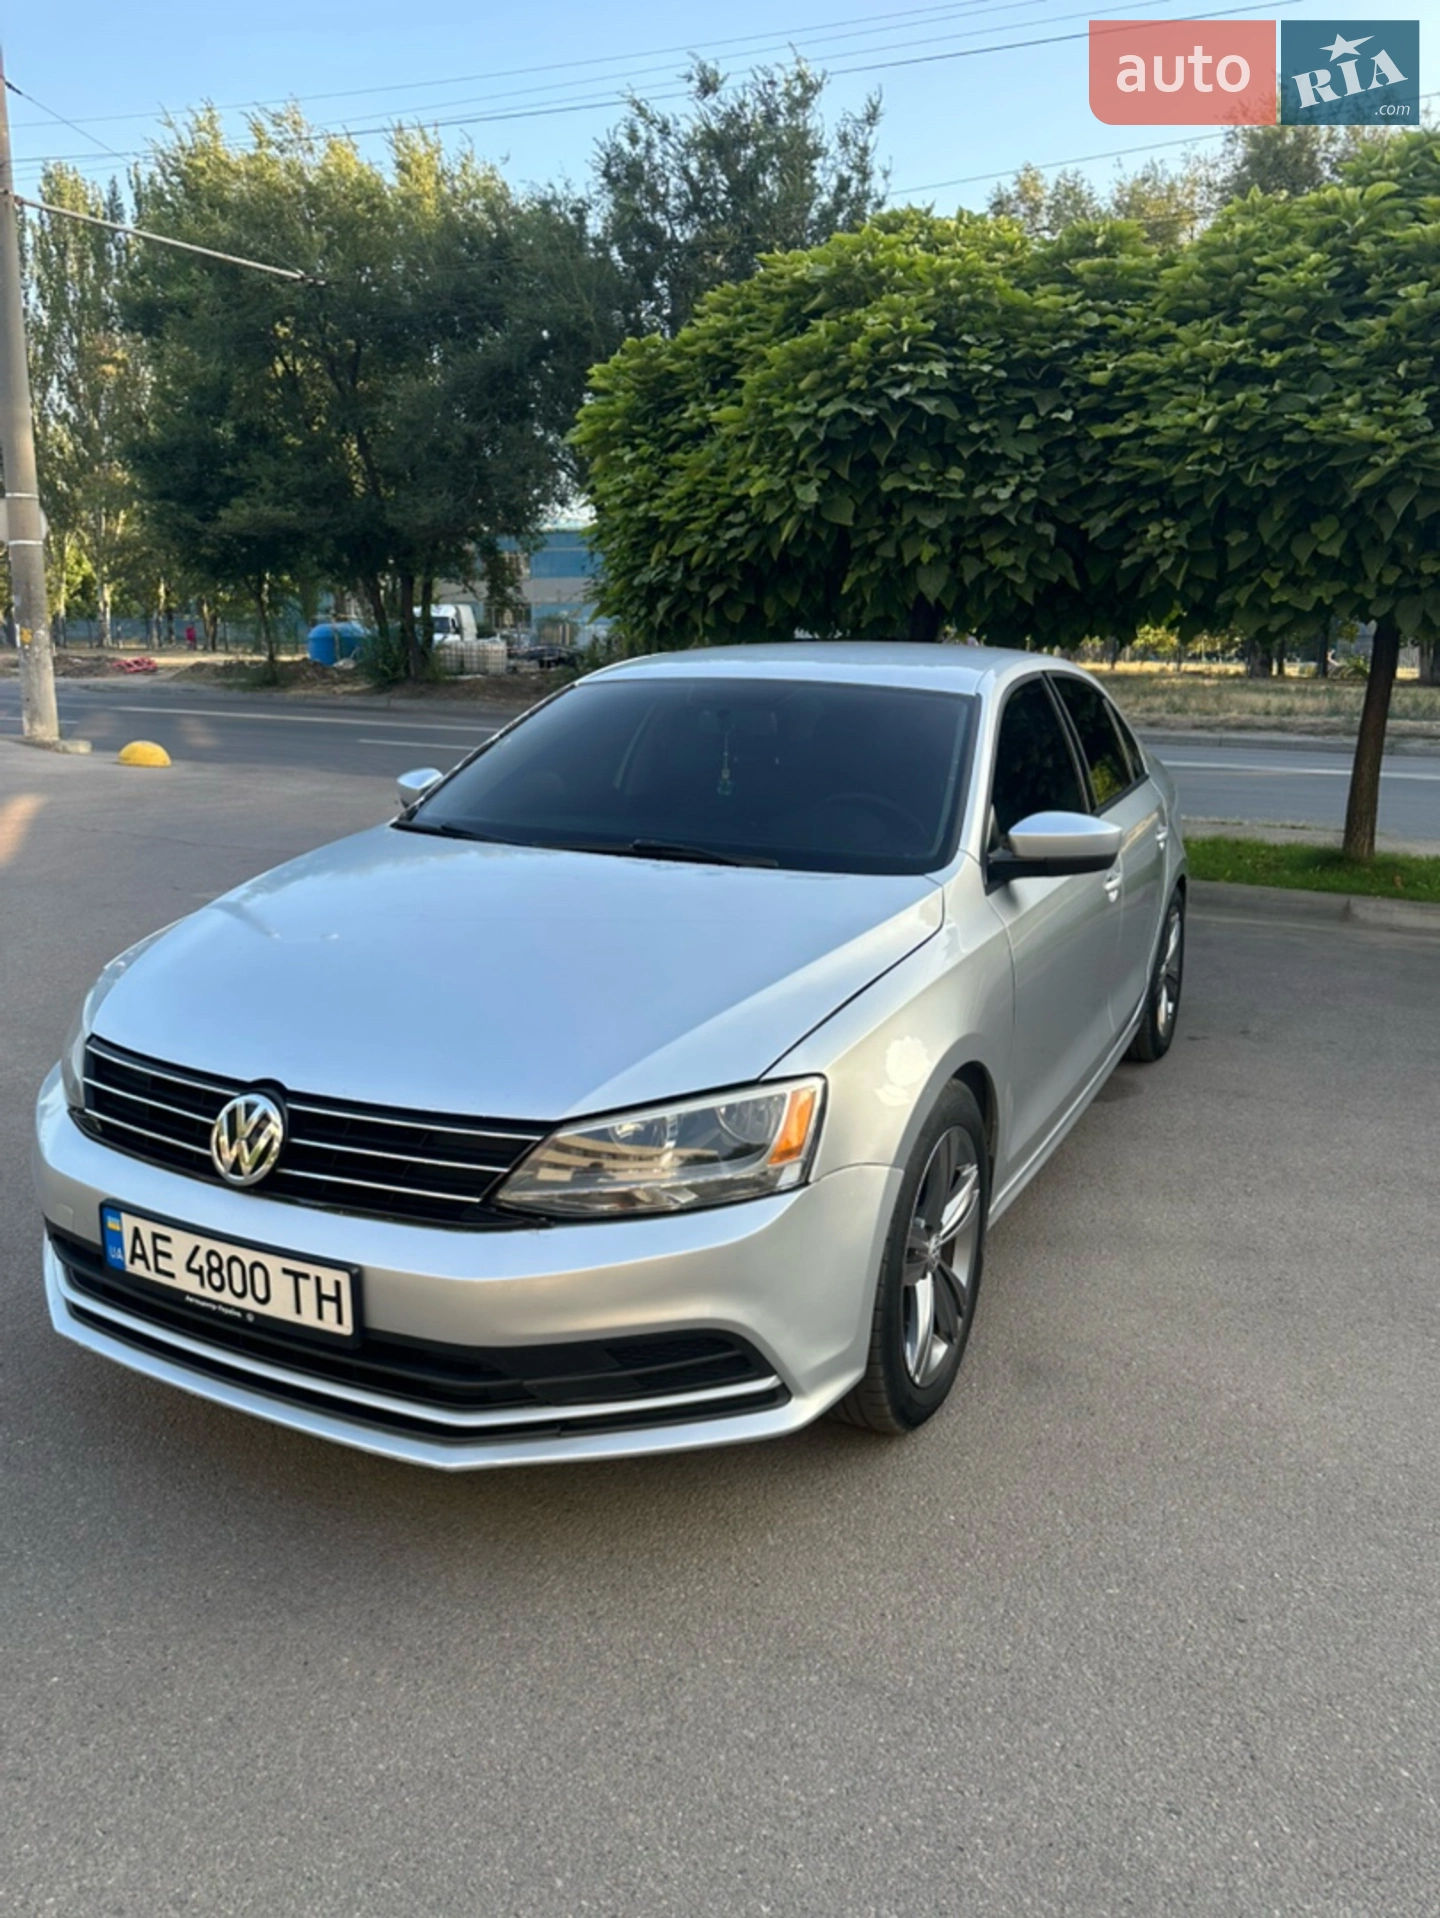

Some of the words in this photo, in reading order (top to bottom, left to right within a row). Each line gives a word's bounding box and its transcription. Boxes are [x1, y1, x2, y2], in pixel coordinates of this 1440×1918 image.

[108, 1245, 124, 1261] UA
[129, 1226, 176, 1279] AE
[186, 1245, 271, 1305] 4800
[282, 1267, 343, 1326] TH
